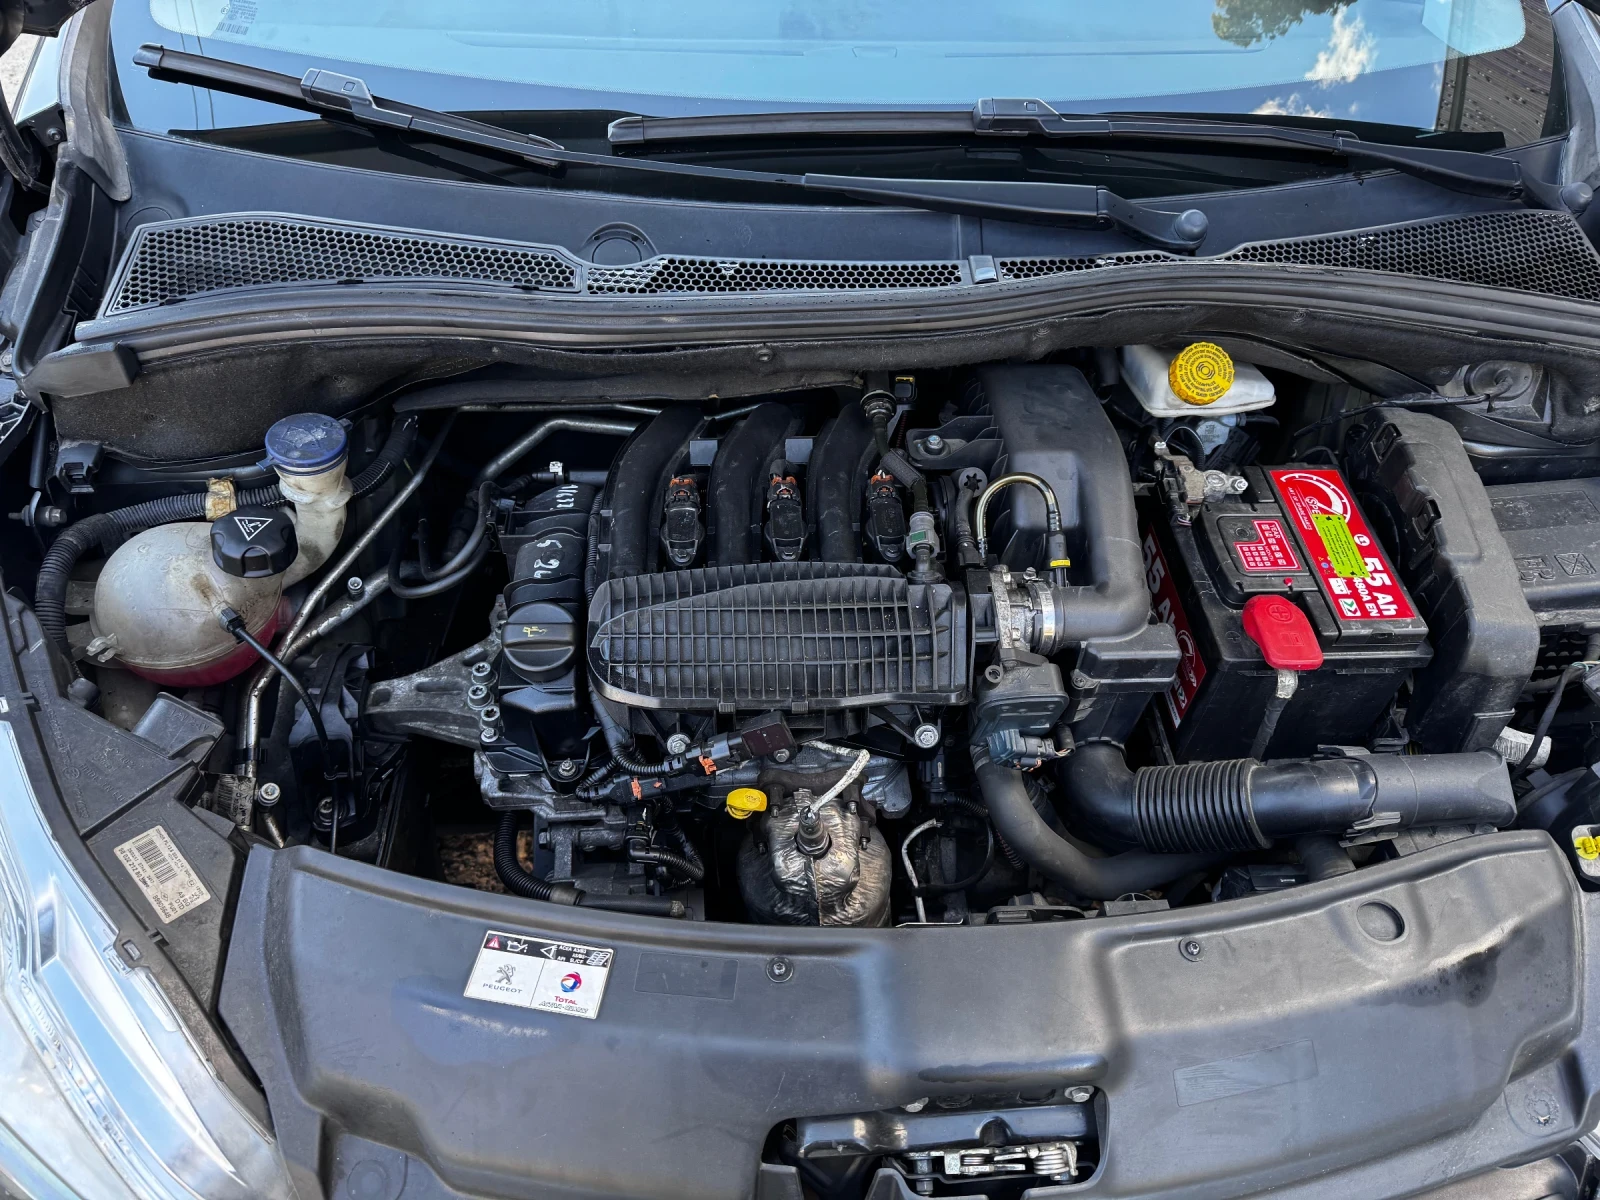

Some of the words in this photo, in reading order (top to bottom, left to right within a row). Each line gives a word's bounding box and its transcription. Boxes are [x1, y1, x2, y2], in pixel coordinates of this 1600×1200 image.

[1269, 524, 1280, 538] YEAR
[1143, 535, 1165, 593] 55
[1362, 556, 1392, 587] 55
[1364, 602, 1381, 617] EN
[1373, 593, 1399, 616] Ah
[482, 983, 523, 994] PEUGEOT
[554, 995, 578, 1005] TOTAL
